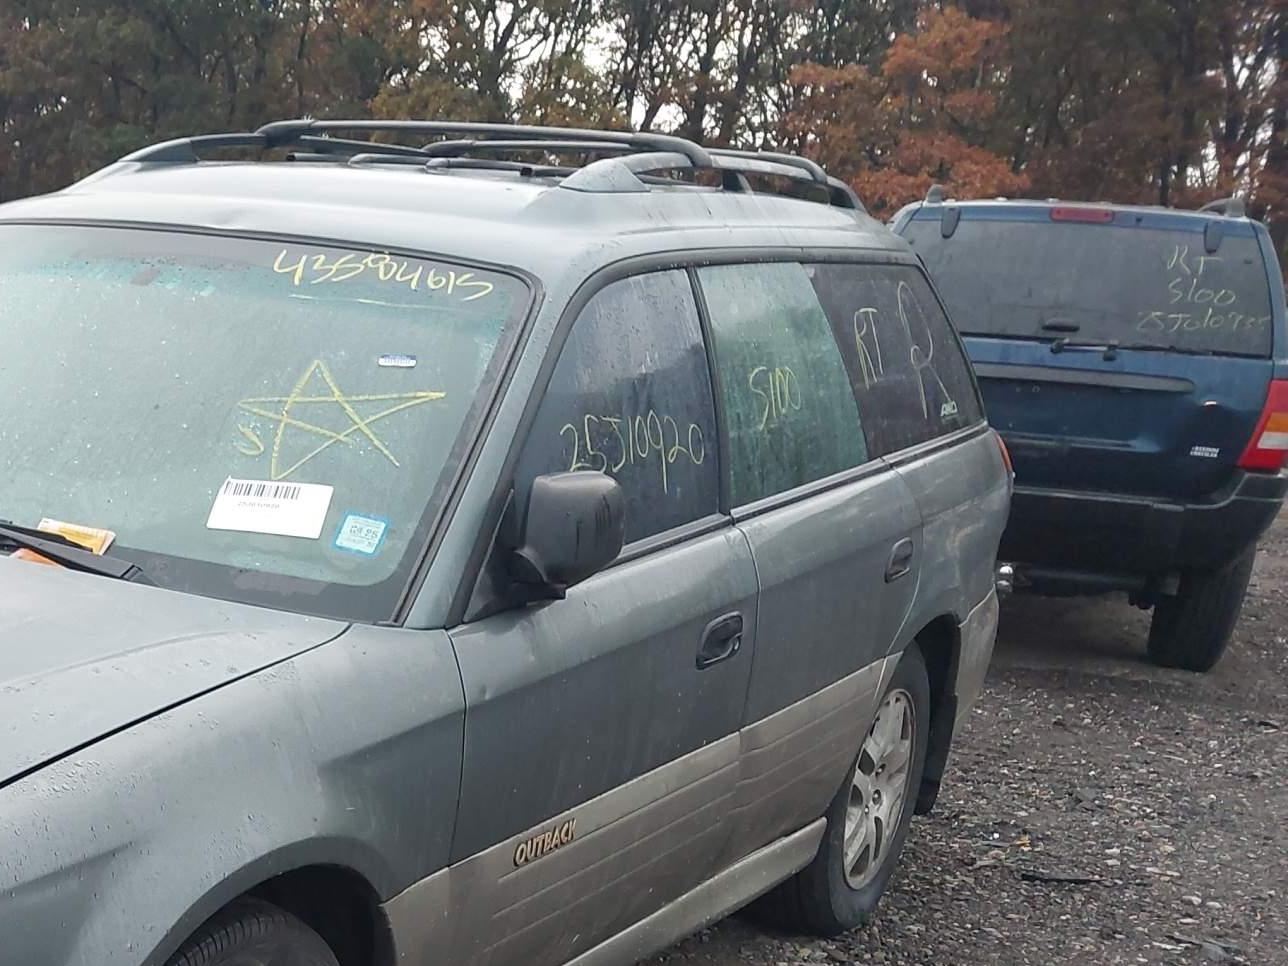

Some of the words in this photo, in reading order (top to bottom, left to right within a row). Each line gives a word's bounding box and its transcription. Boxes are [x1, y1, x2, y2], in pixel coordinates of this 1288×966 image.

[272, 248, 494, 302] 43584615
[853, 307, 884, 391] RT
[559, 408, 706, 496] 25J10920
[512, 818, 576, 867] OUTBACK
